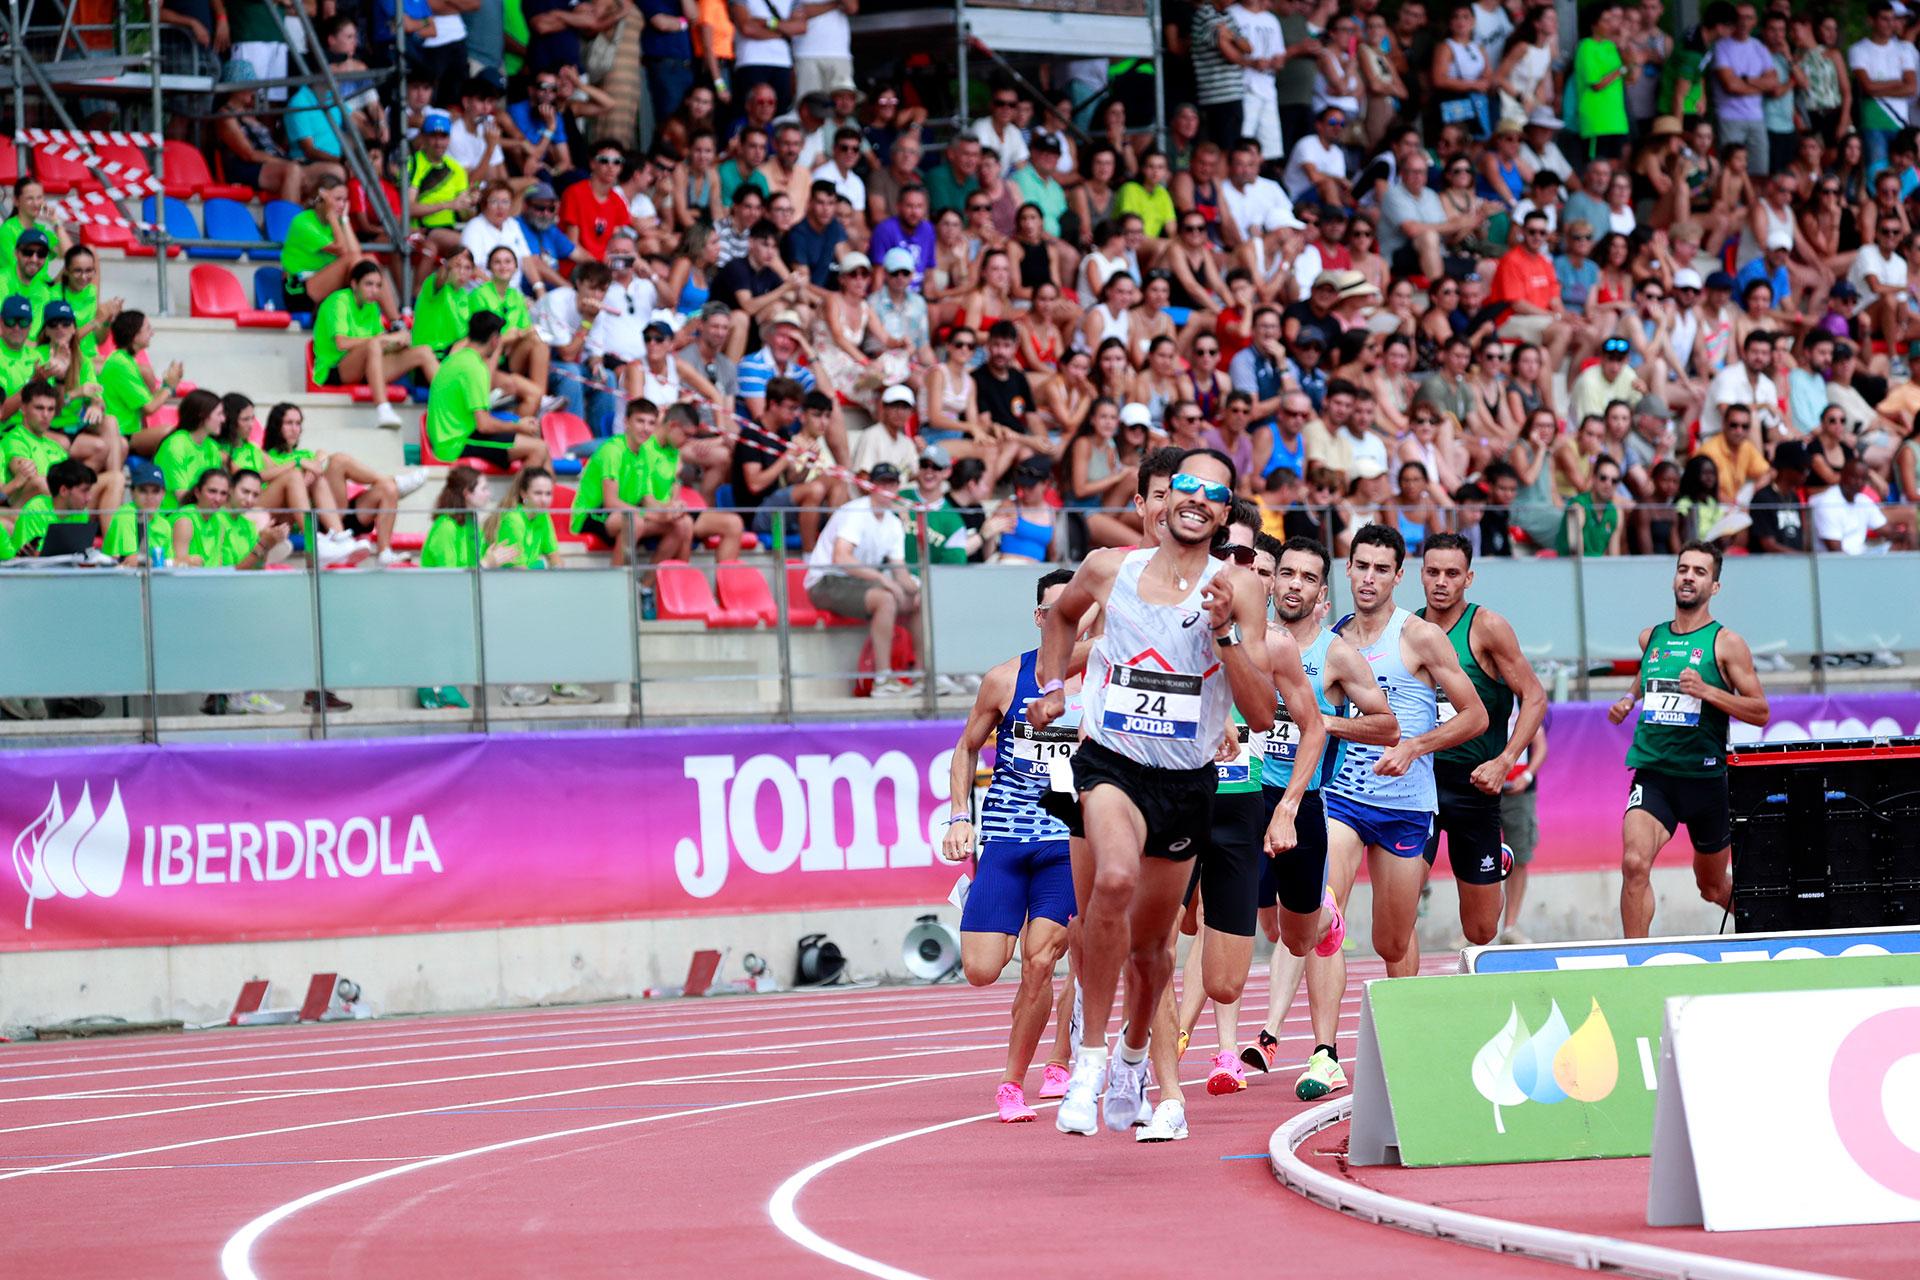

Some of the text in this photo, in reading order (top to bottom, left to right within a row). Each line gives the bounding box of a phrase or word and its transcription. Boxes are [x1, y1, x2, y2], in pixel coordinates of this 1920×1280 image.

[1135, 693, 1167, 717] 24
[1662, 695, 1681, 710] 77
[1122, 716, 1176, 735] Joma
[1652, 711, 1687, 722] Joma
[1034, 743, 1071, 761] 119
[1265, 741, 1290, 755] ma
[142, 814, 444, 887] IBERDROLA
